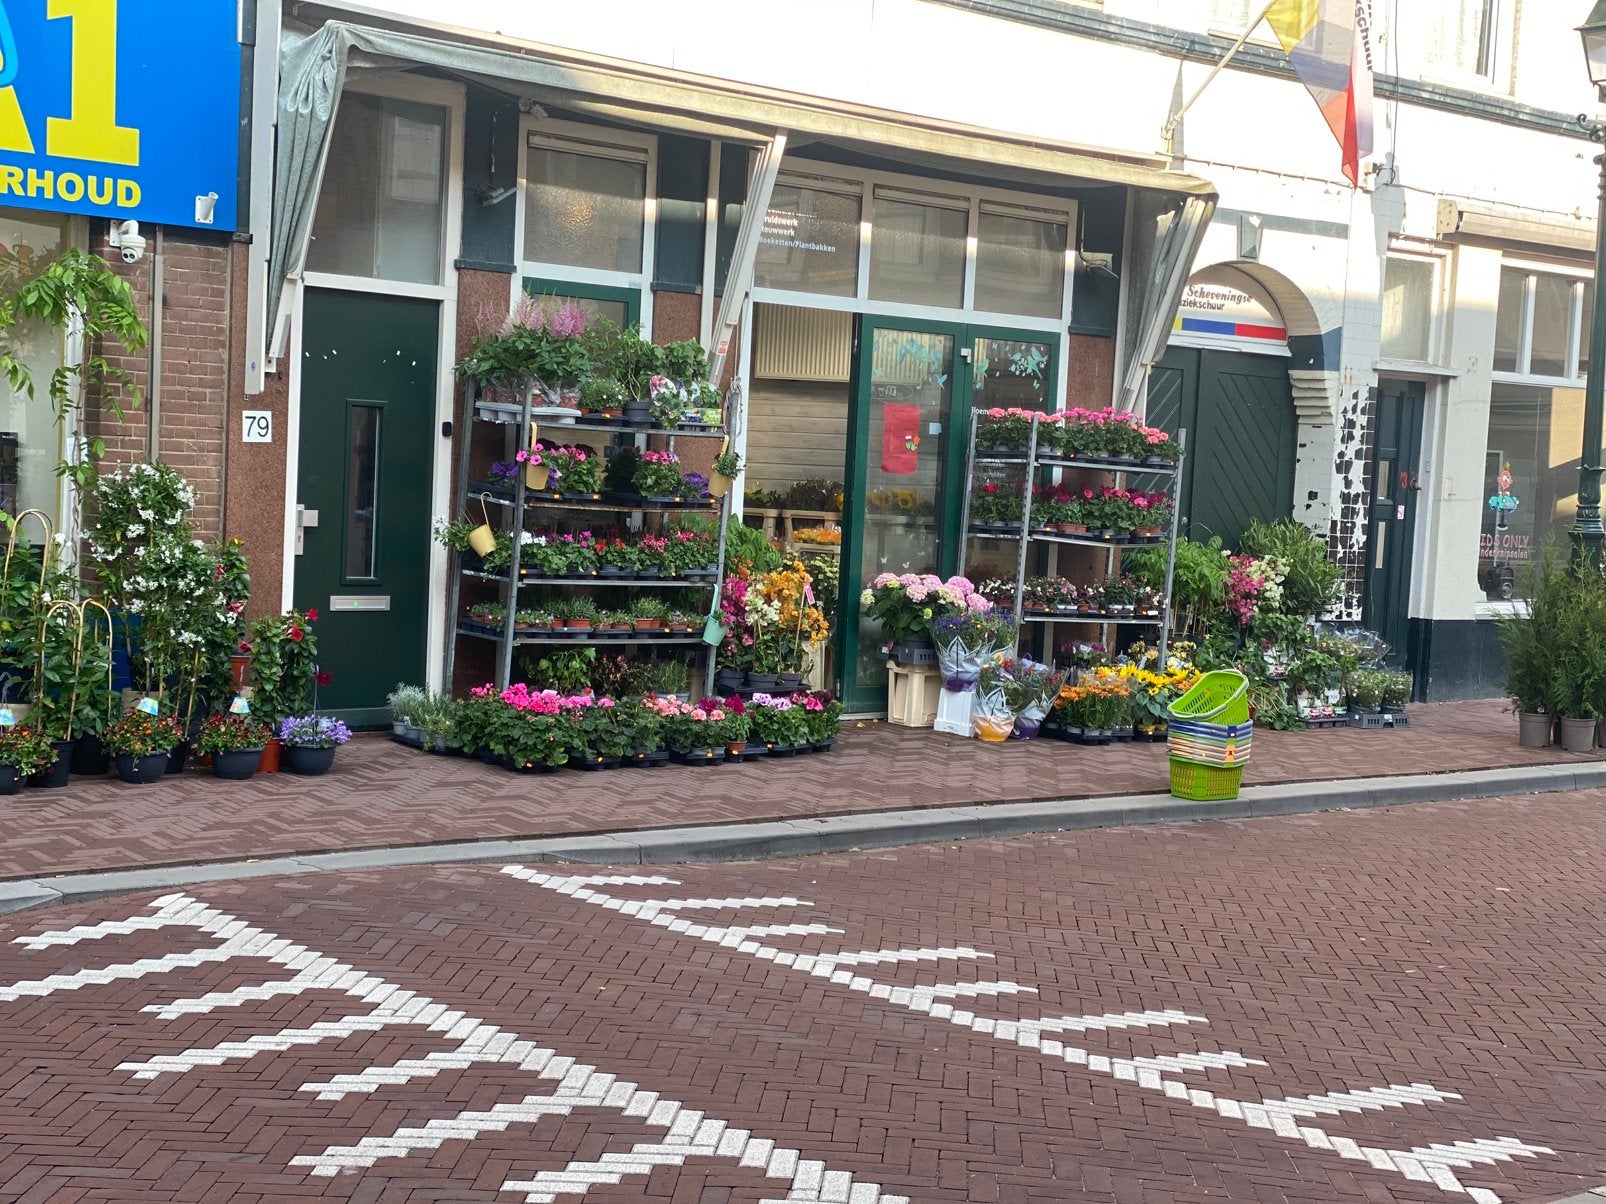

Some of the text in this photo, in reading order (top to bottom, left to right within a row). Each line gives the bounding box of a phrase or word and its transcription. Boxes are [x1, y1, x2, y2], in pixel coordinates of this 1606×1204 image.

[1187, 285, 1252, 304] Scheveningse
[244, 415, 270, 437] 79
[1503, 534, 1529, 548] ONLY
